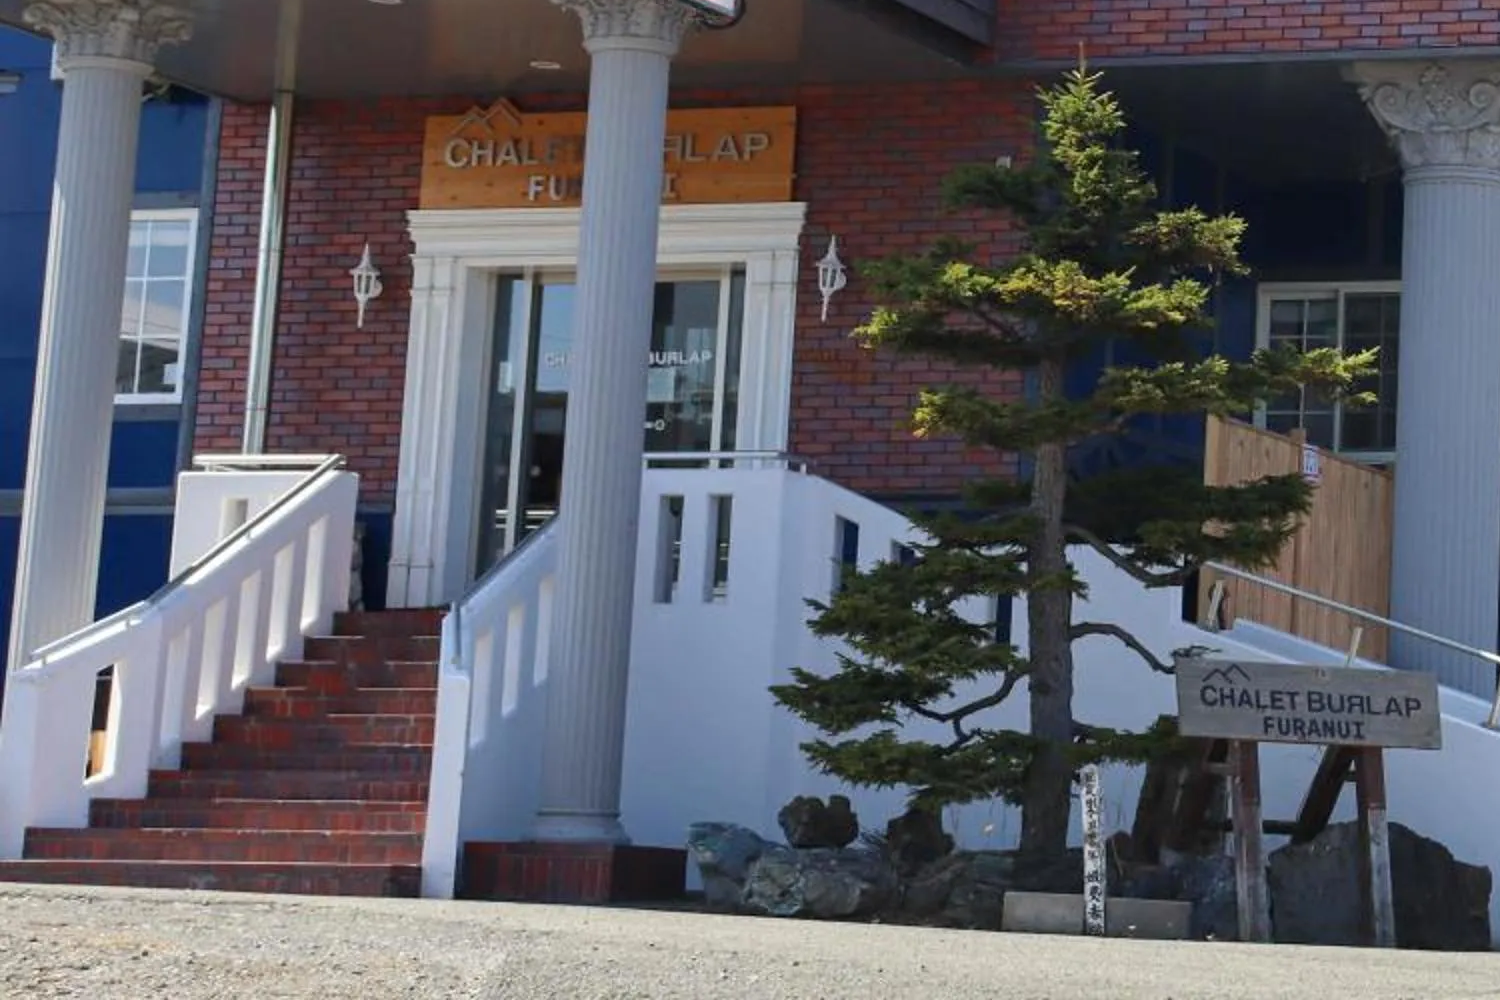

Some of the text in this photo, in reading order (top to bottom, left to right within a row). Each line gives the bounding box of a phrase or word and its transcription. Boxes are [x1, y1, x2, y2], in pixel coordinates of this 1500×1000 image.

[661, 131, 769, 163] RLAP
[1200, 684, 1300, 711] CHALET
[1263, 716, 1366, 740] FURANUI
